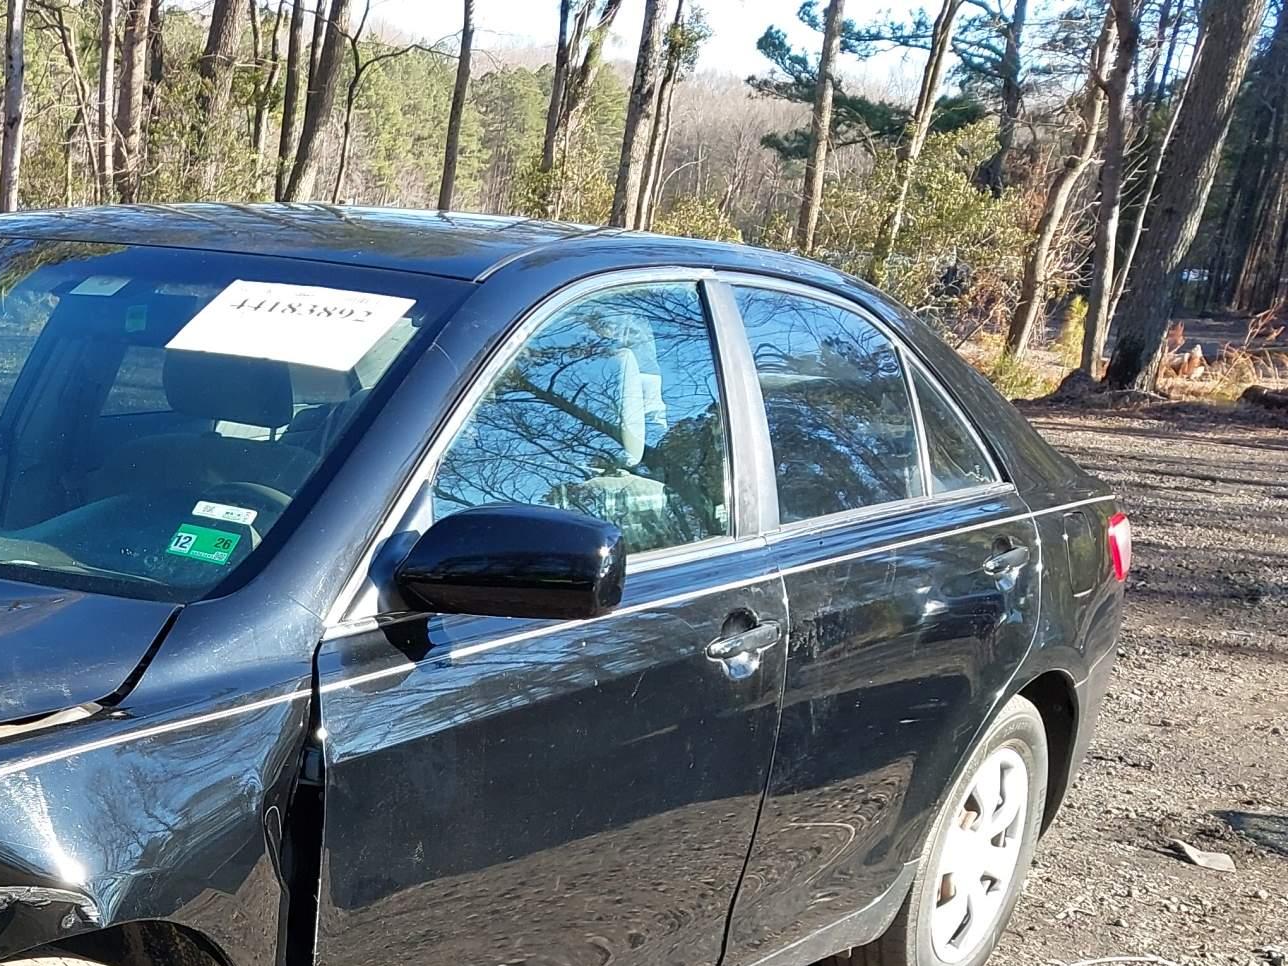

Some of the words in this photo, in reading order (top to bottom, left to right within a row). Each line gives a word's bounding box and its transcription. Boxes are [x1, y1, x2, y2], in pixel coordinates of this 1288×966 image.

[230, 298, 373, 323] 44183892
[173, 534, 193, 549] 12
[214, 537, 233, 550] 26
